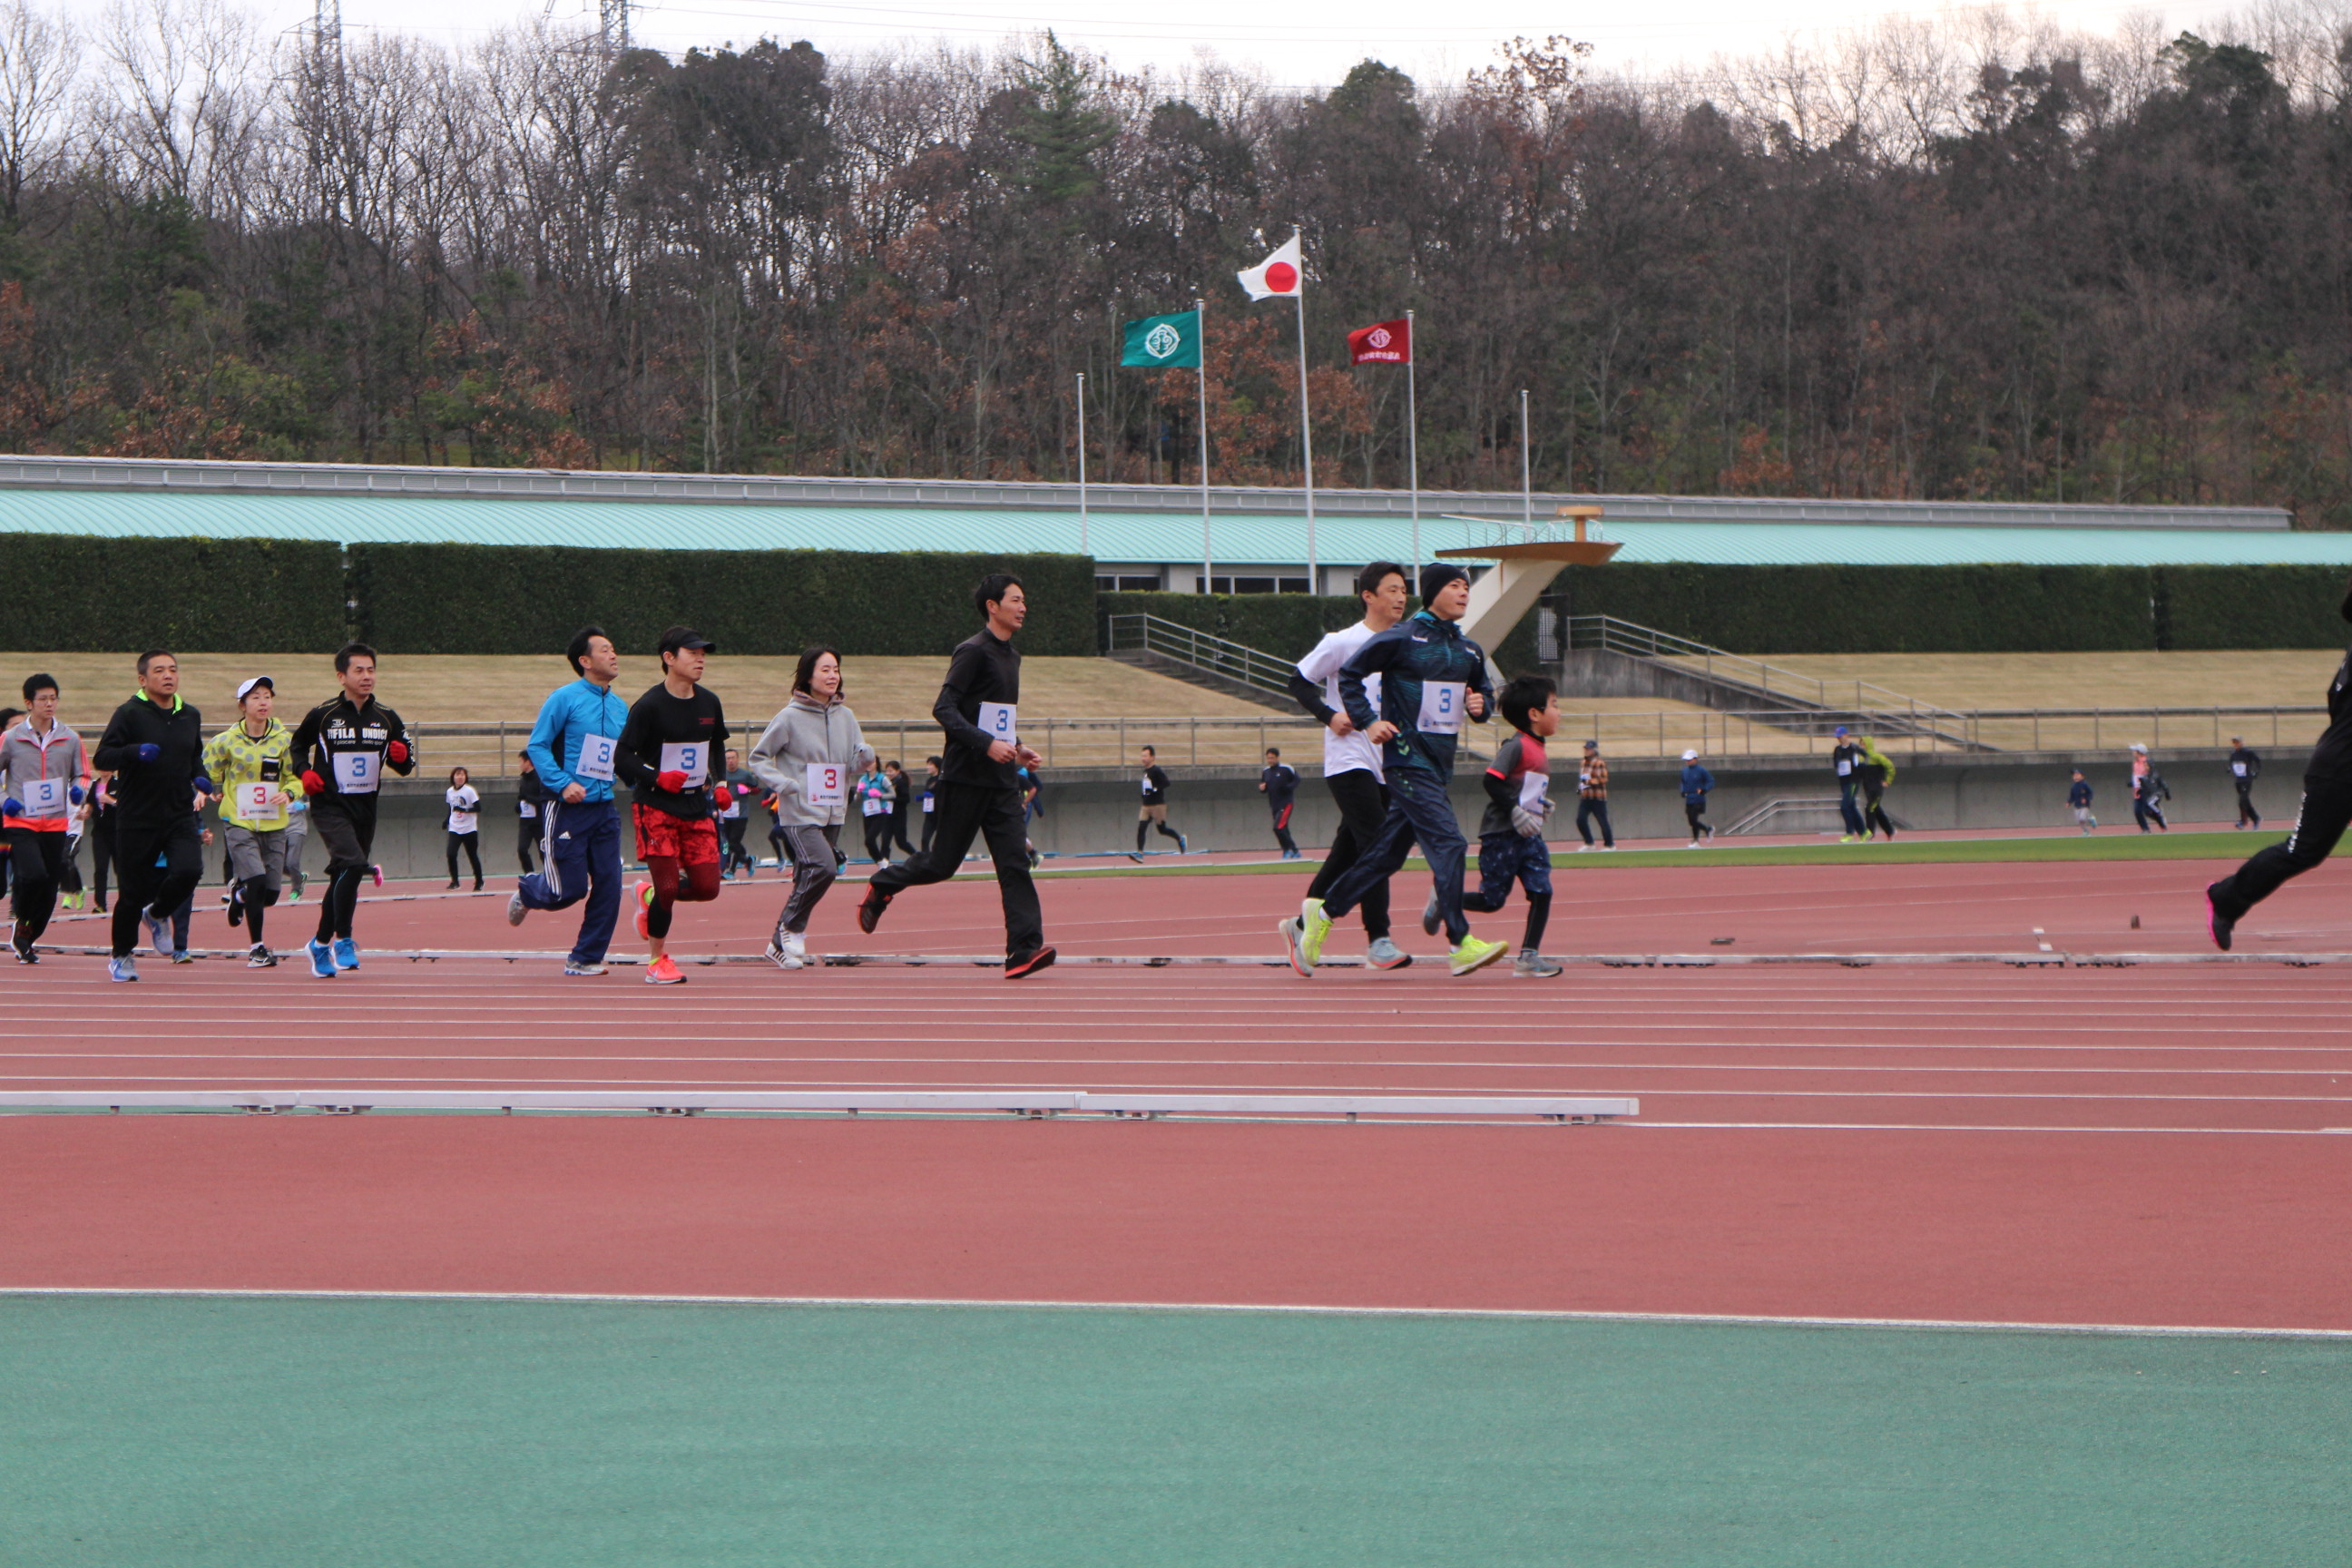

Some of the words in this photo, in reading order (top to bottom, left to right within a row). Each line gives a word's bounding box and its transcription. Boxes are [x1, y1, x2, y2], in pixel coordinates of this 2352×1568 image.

[1439, 688, 1452, 713] 3
[996, 710, 1008, 731] 3
[598, 743, 611, 763] 3
[681, 748, 697, 770] 3
[352, 757, 367, 778] 3
[824, 769, 837, 789] 3
[40, 783, 52, 800] 3
[253, 787, 266, 805] 3
